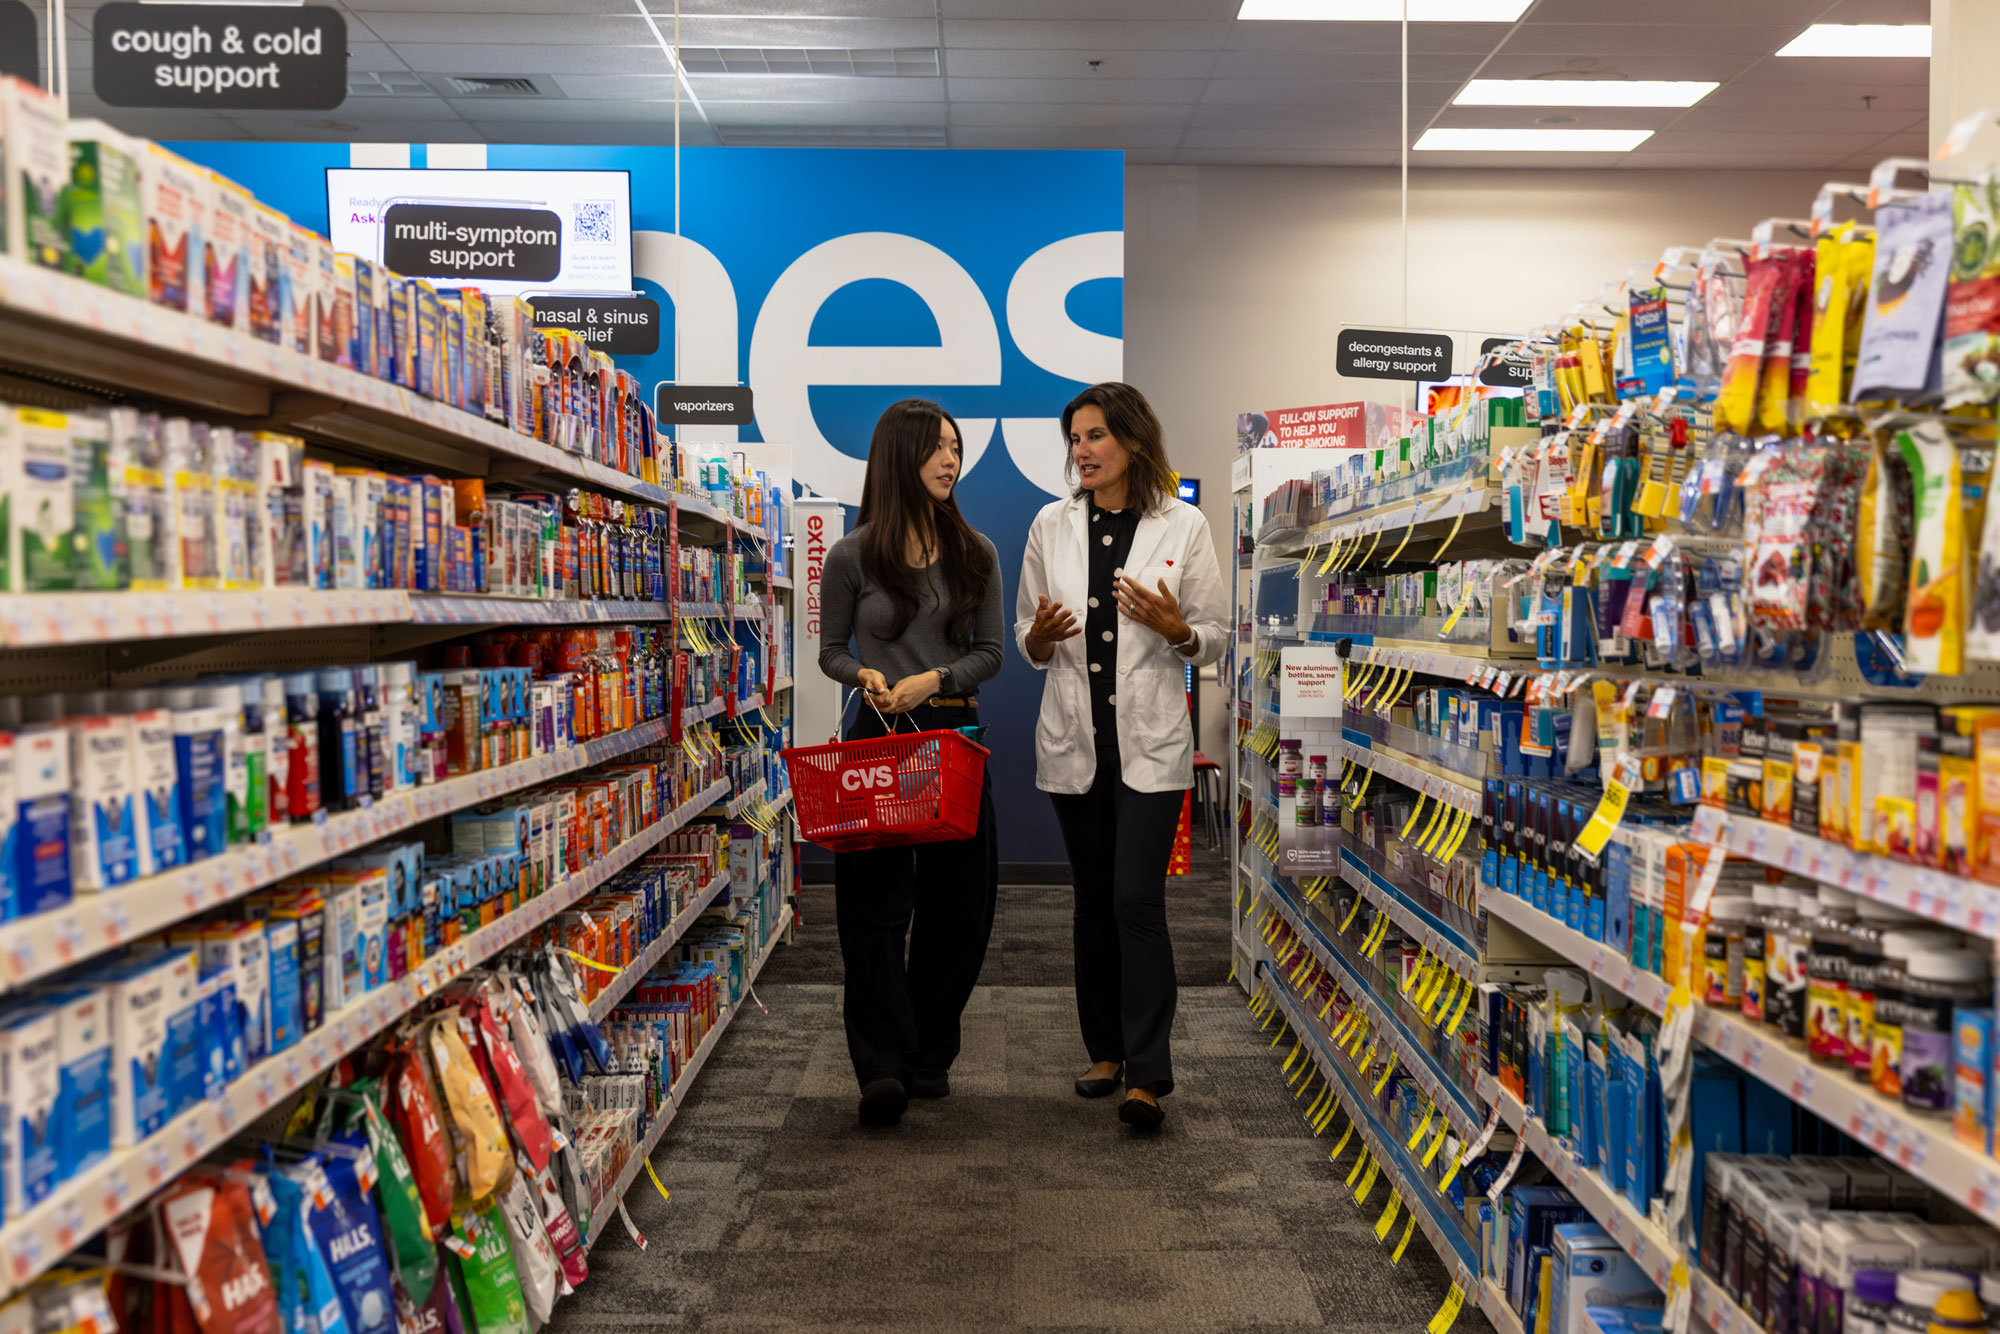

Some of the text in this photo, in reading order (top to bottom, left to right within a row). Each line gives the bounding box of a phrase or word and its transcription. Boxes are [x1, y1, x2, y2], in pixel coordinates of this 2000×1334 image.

[111, 26, 322, 60] cough & cold
[155, 60, 280, 92] support
[350, 213, 376, 224] Ask
[395, 221, 557, 248] multi-symptom
[429, 249, 515, 270] support
[535, 309, 648, 325] nasal & sinus
[1348, 342, 1443, 357] decongestants &
[1353, 358, 1437, 373] allergy support
[674, 400, 734, 414] vaporizers
[1279, 406, 1360, 425] FULL-ON SUPPORT
[1280, 423, 1337, 438] TO HELP YOU
[1280, 436, 1346, 449] STOP SMOKING
[842, 765, 894, 791] CVS
